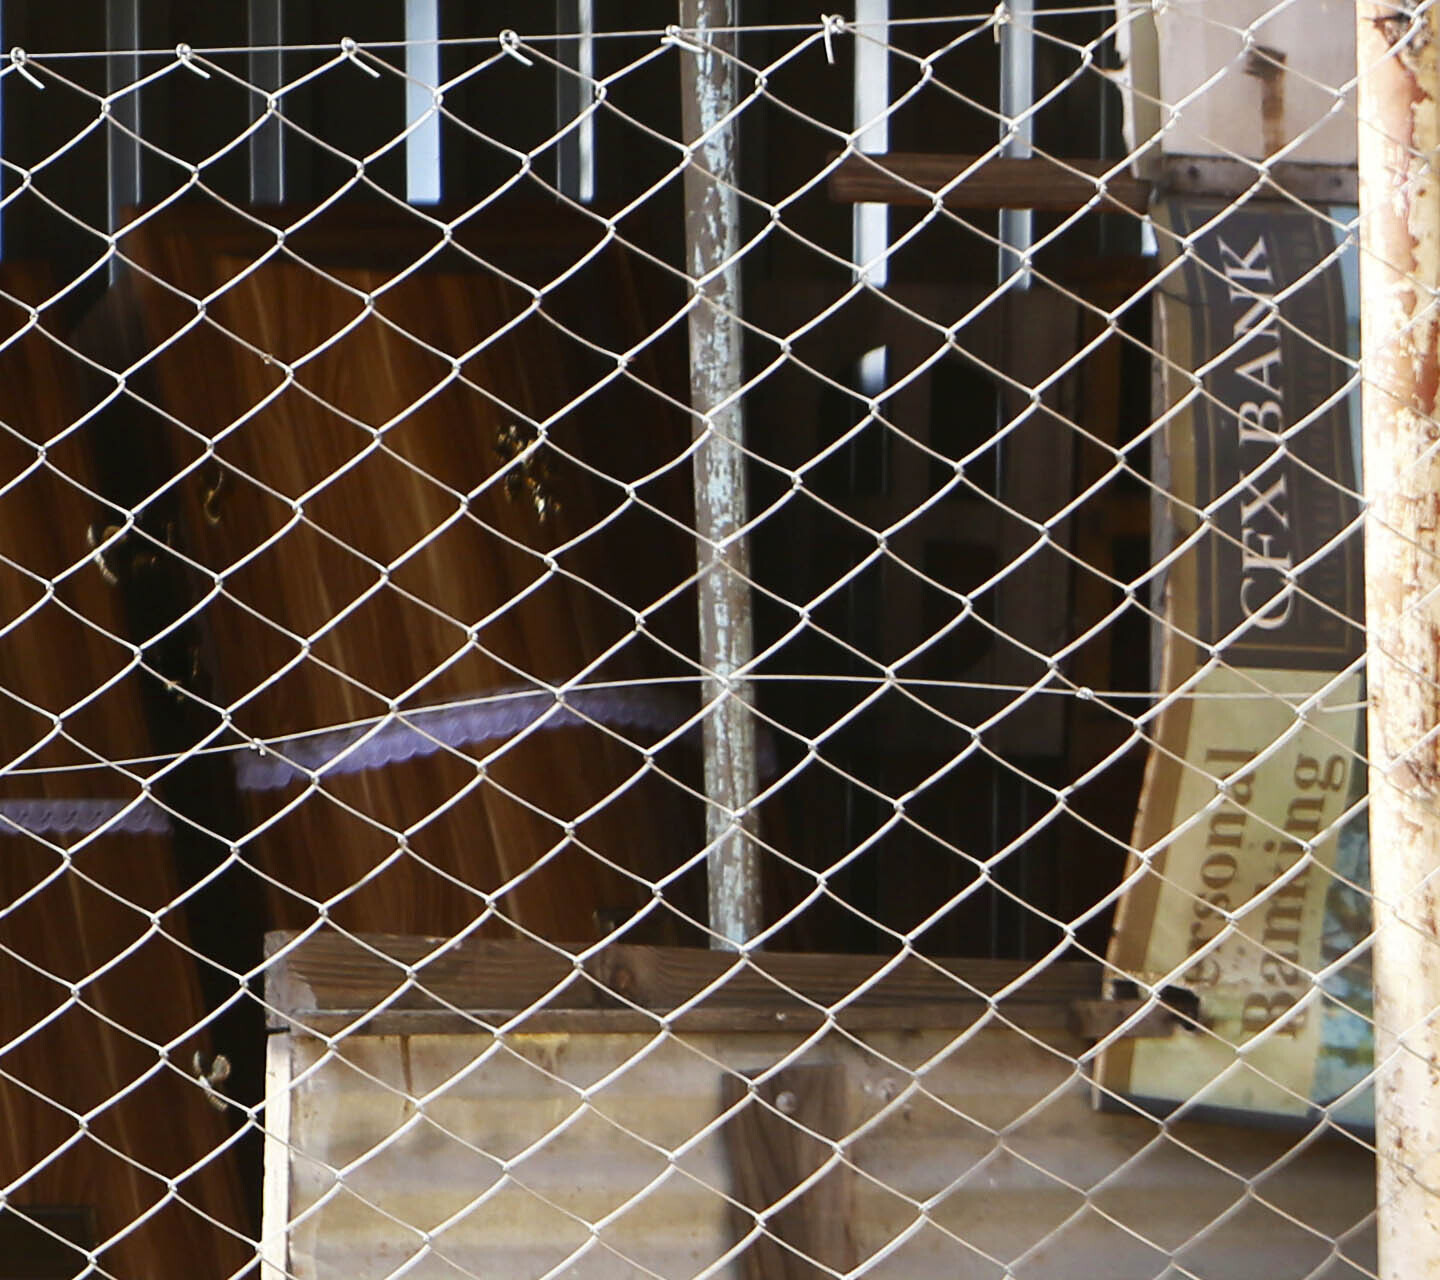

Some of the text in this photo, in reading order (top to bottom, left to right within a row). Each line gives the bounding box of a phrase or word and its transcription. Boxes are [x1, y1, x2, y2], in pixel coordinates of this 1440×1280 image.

[1217, 234, 1295, 631] CFX BANK
[1184, 748, 1260, 988] ersonal
[1240, 752, 1348, 1041] Banking
